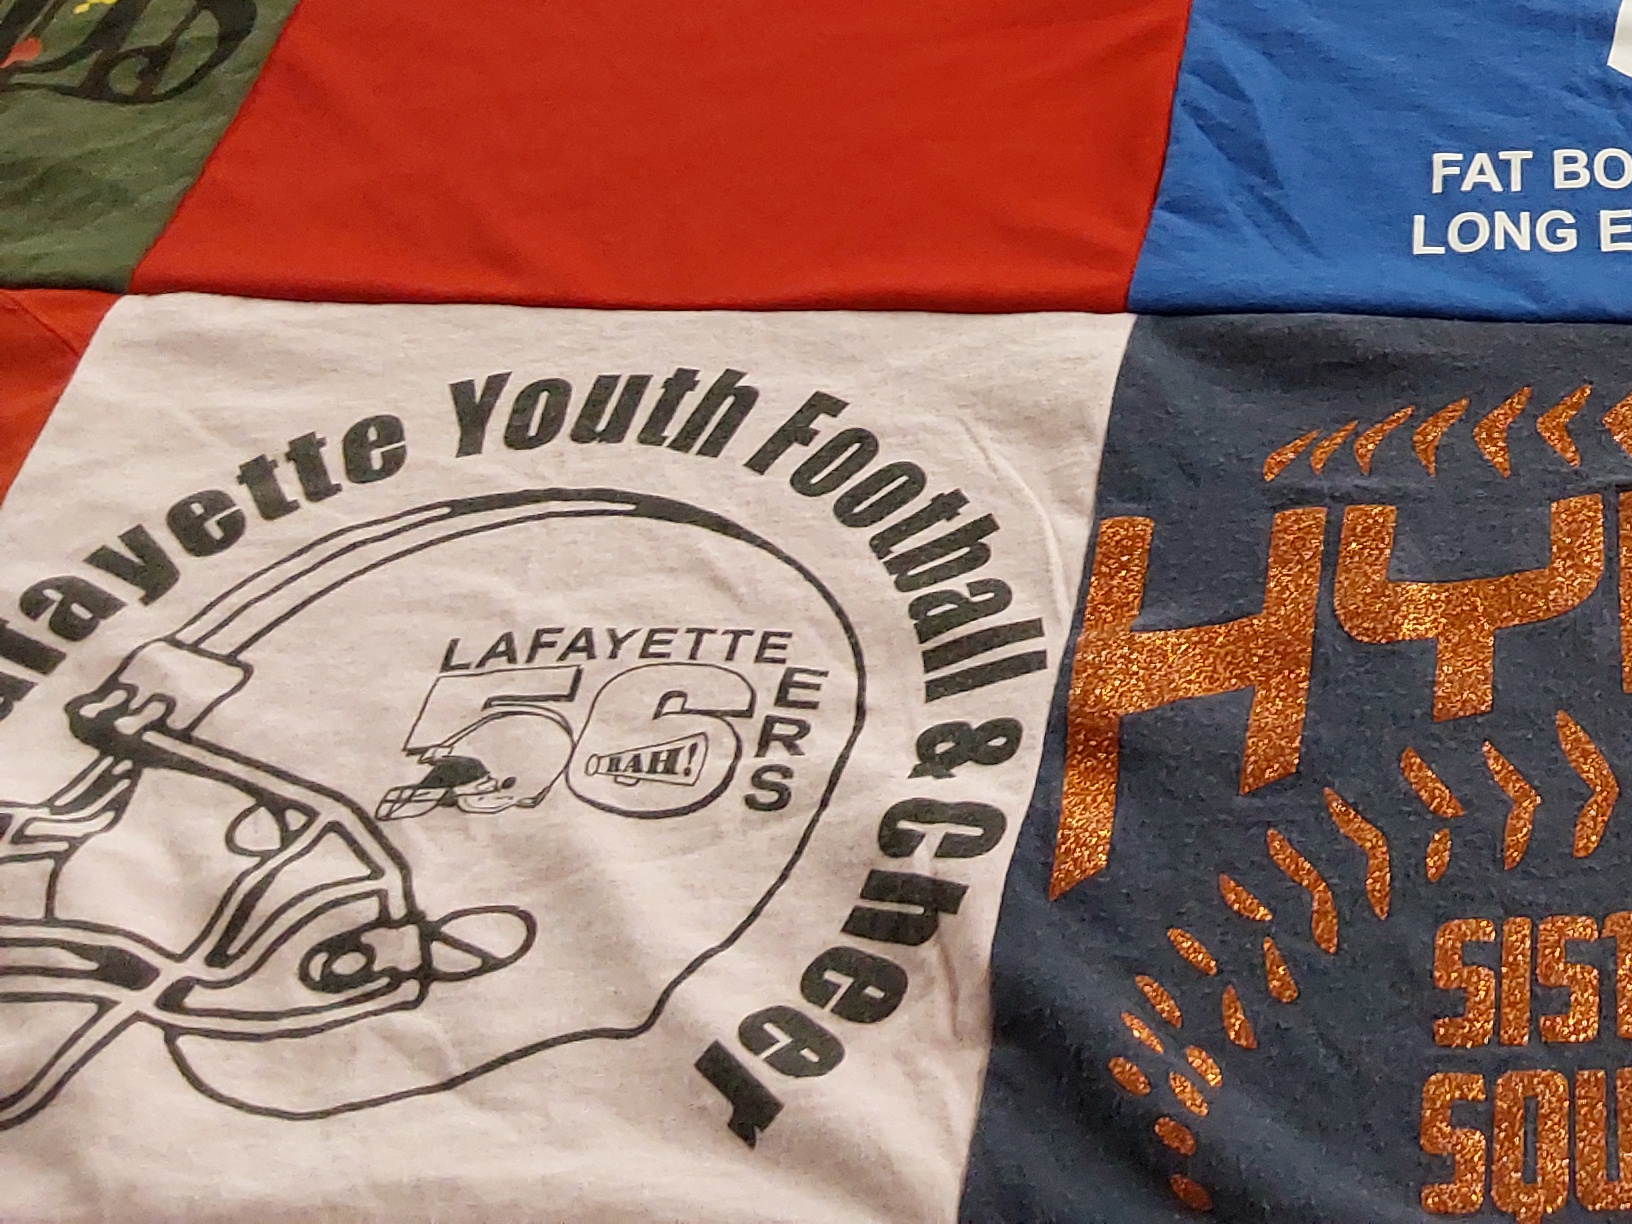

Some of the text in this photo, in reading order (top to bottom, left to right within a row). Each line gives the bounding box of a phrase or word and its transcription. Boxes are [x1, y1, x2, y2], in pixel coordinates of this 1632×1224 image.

[1430, 150, 1534, 194] FAT
[1411, 209, 1578, 255] LONG
[448, 368, 762, 462] Youth
[752, 388, 1049, 703] Football
[440, 626, 794, 674] LAFAYETTE
[402, 662, 766, 820] 56
[908, 717, 1023, 782] &
[693, 794, 1006, 1150] Cheer
